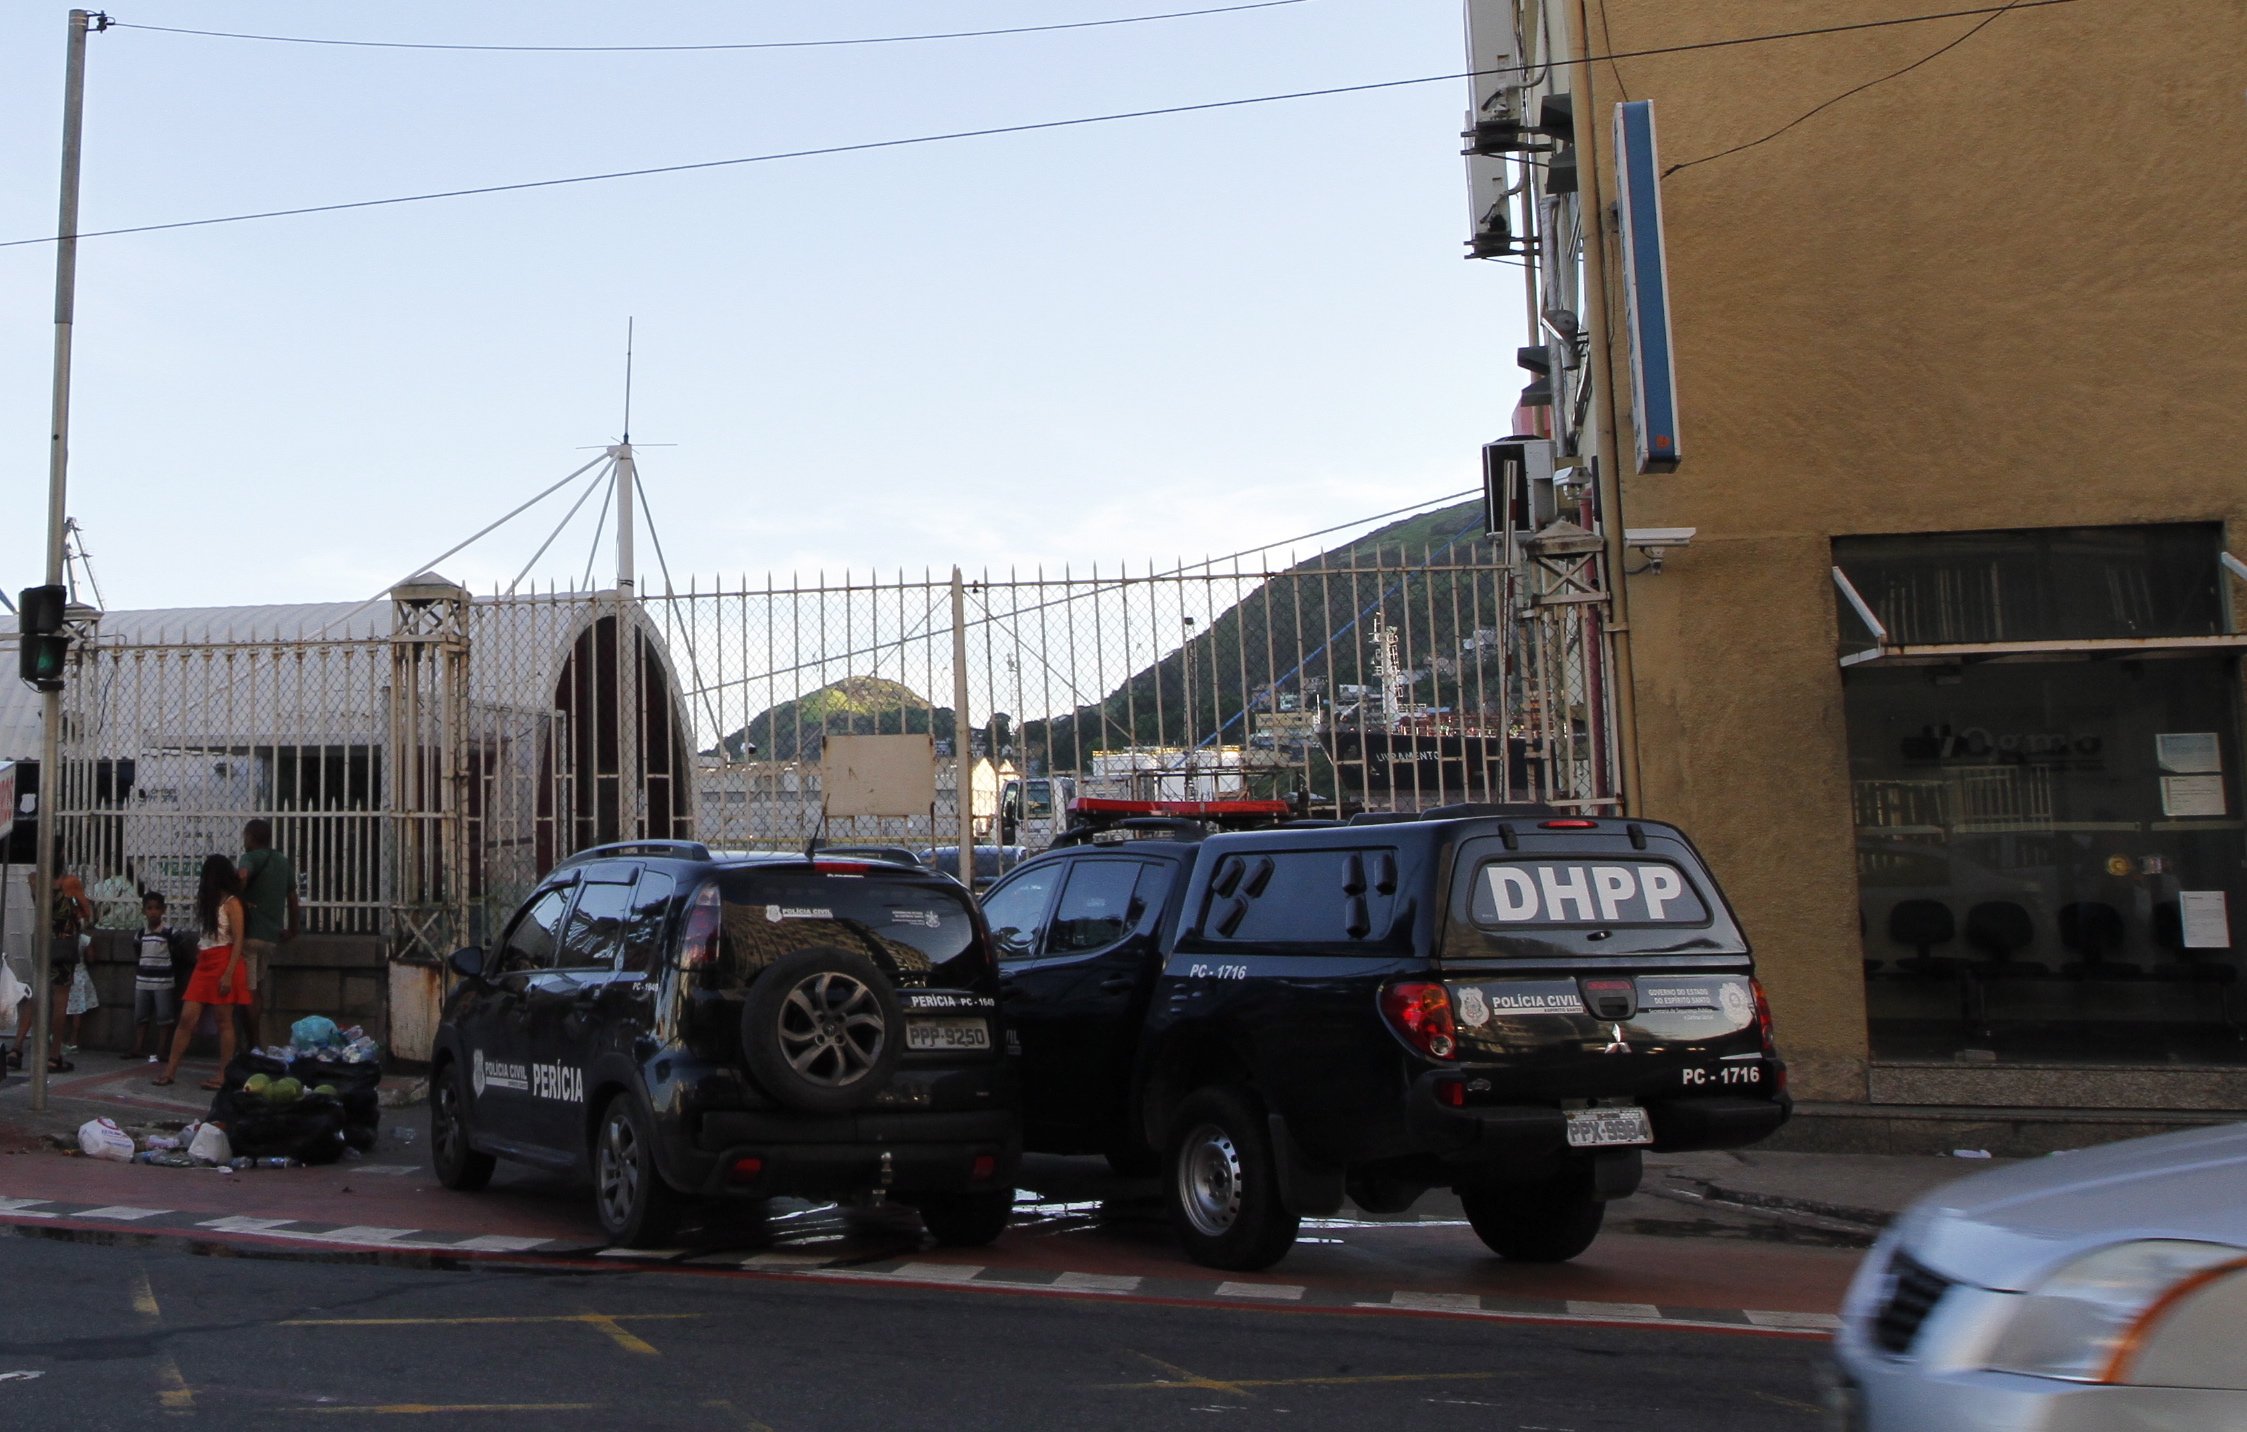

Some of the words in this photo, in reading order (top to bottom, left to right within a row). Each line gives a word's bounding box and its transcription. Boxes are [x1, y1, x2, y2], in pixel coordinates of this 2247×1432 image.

[1487, 866, 1682, 921] DHPP
[1190, 964, 1208, 978] PC
[1217, 965, 1247, 980] 1716
[1648, 988, 1676, 996] GOVERNO
[1676, 988, 1686, 996] DO
[1686, 988, 1709, 996] ESTADO
[911, 994, 956, 1007] PERÍCIA
[961, 998, 973, 1006] PC
[1492, 994, 1545, 1008] POLÍCIA
[1547, 995, 1581, 1007] CIVIL
[1654, 997, 1664, 1005] DO
[1692, 996, 1711, 1004] SANTO
[485, 1060, 509, 1078] POLÍCIA
[509, 1064, 528, 1080] CIVIL
[1683, 1068, 1705, 1084] PC
[1720, 1067, 1760, 1084] 1716
[533, 1059, 584, 1103] PERÍCIA
